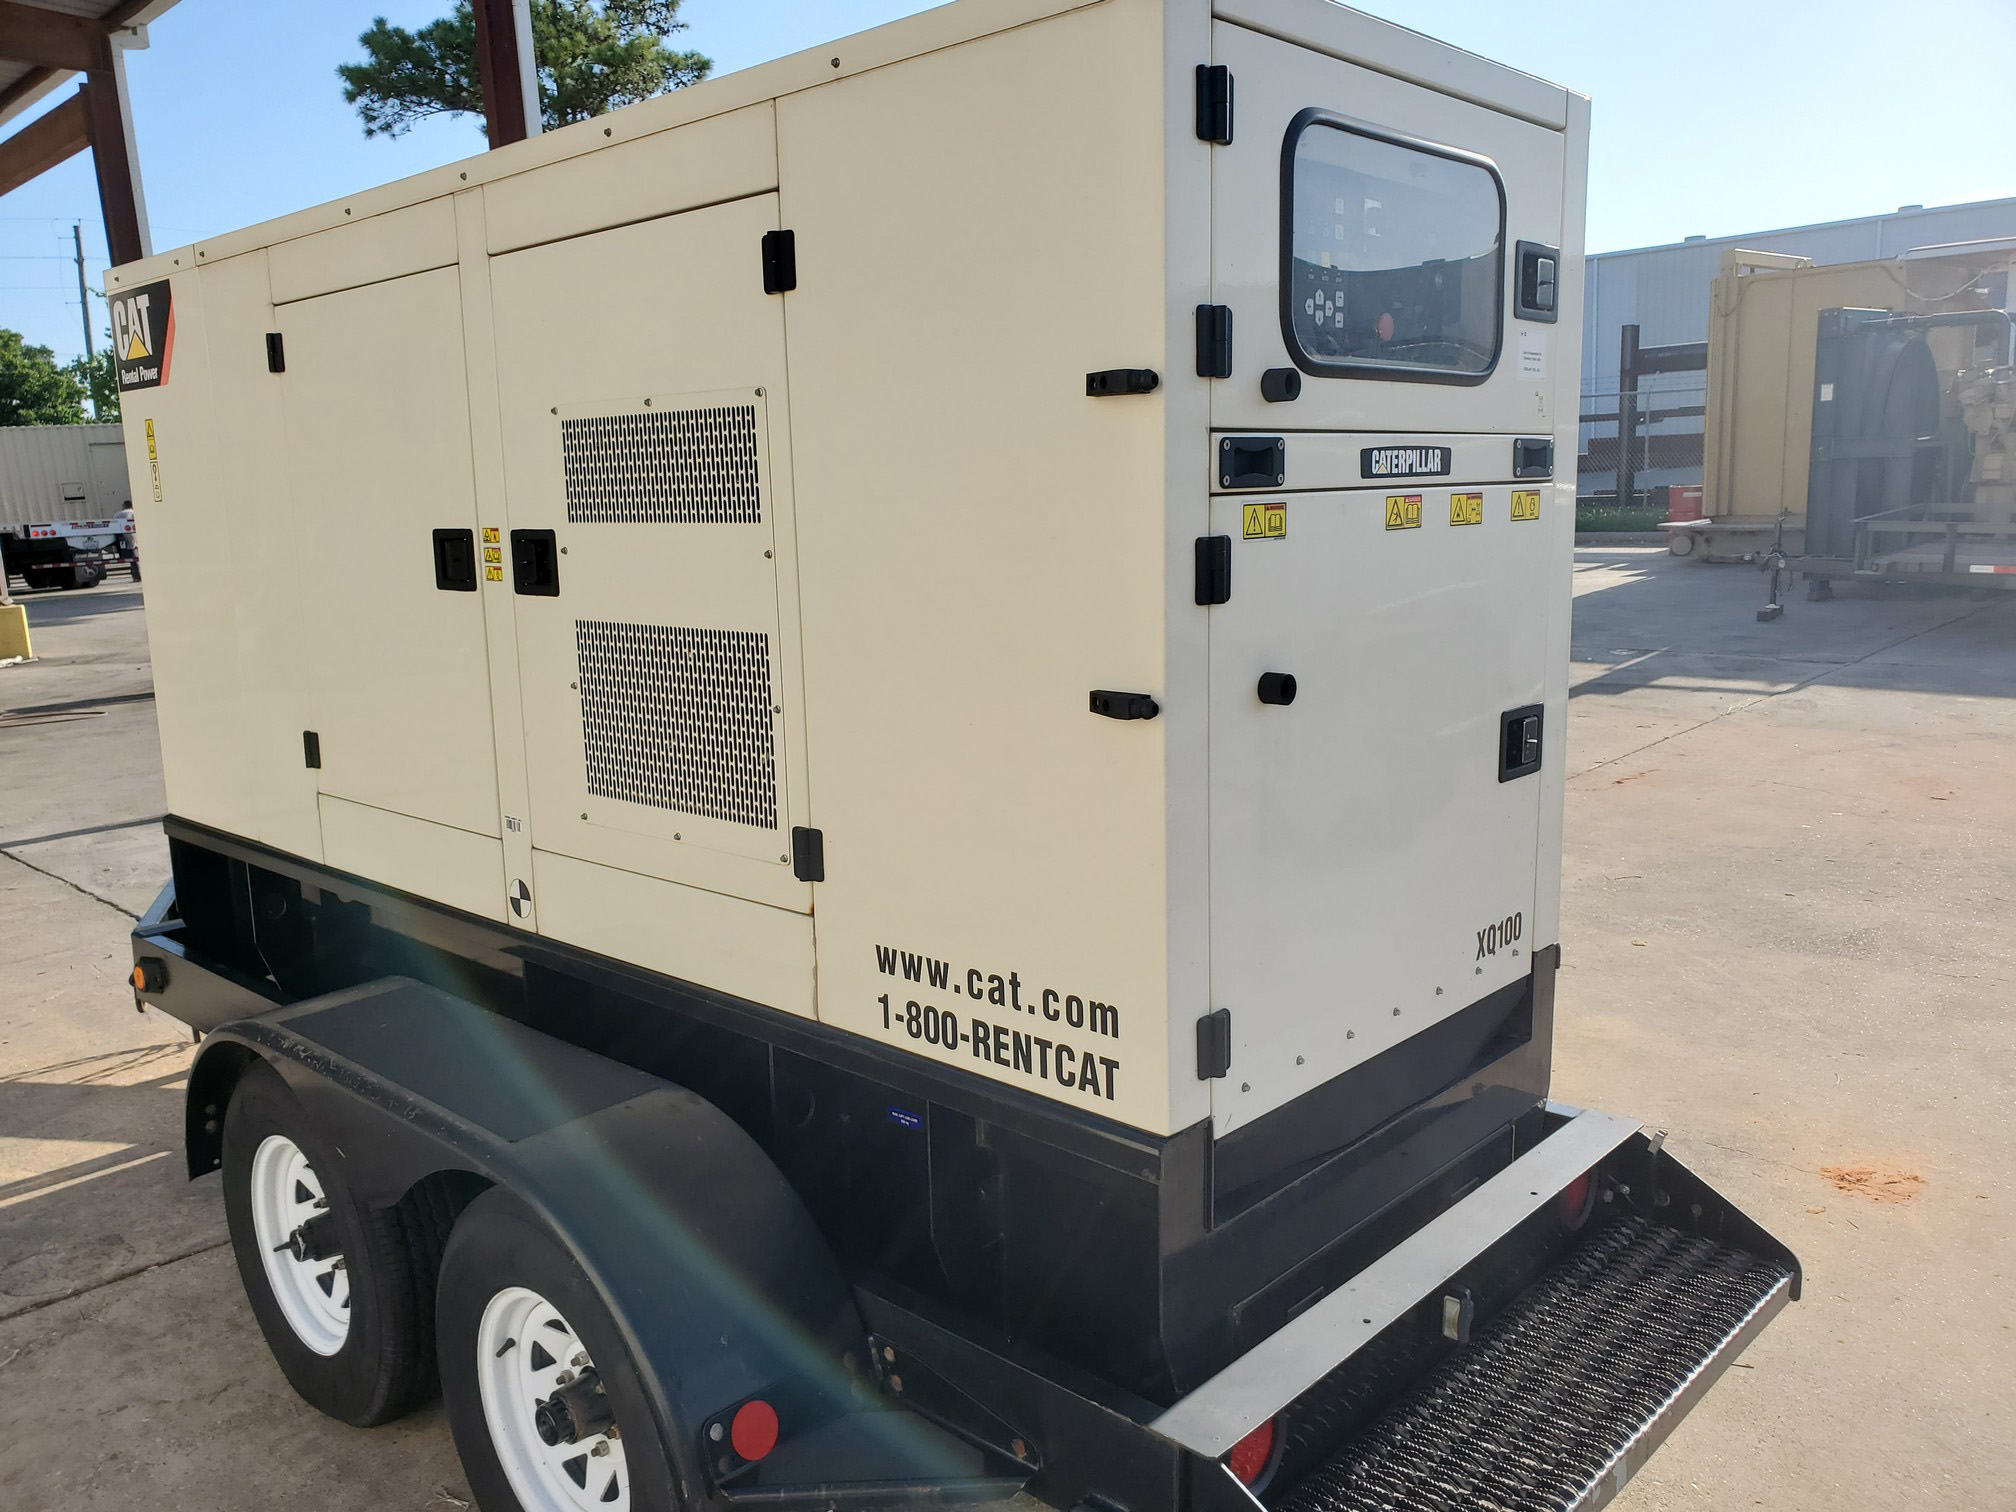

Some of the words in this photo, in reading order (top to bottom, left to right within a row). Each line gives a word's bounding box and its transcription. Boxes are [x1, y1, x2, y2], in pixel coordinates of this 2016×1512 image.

[113, 294, 153, 361] CAT
[121, 367, 139, 385] Rental
[140, 366, 158, 382] Power
[1371, 449, 1441, 474] CATERPILLAR
[1476, 911, 1522, 961] XQ100
[875, 944, 1119, 1039] www.cat.com
[877, 993, 1120, 1101] 1-800-RENTCAT
